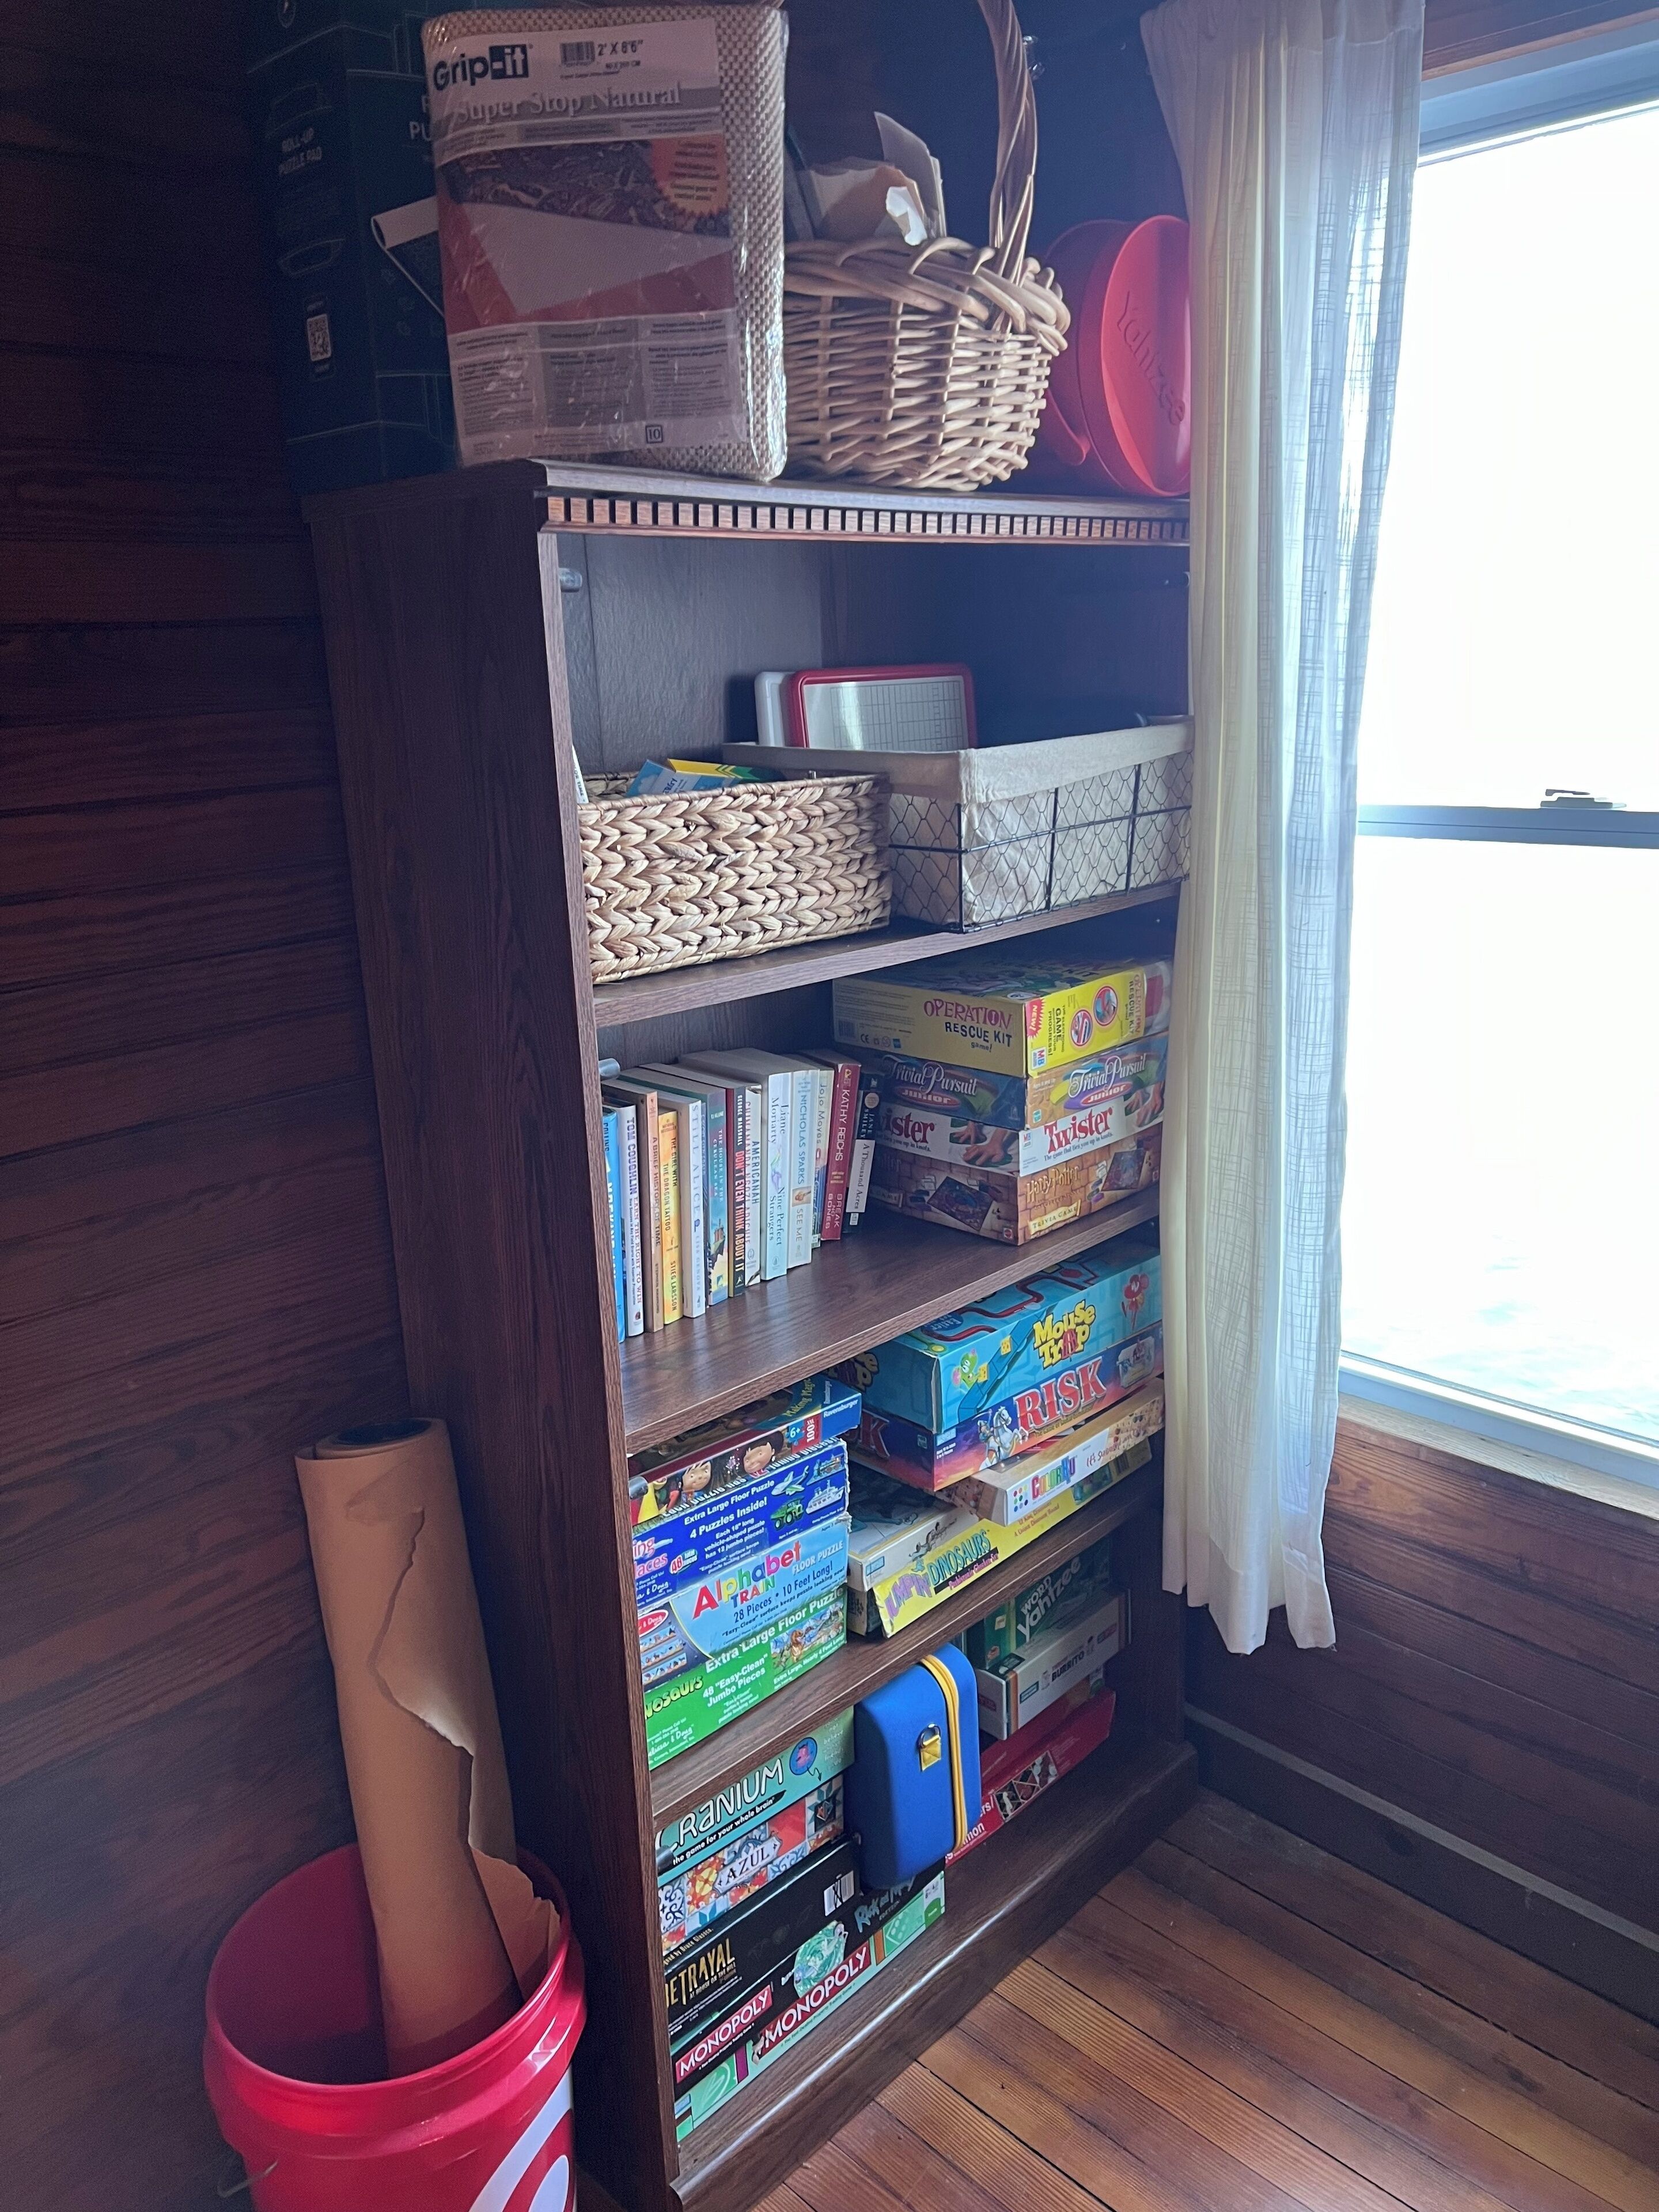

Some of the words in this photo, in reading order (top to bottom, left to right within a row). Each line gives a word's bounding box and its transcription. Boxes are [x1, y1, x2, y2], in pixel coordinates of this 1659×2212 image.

[459, 99, 521, 124] Super
[529, 90, 582, 118] Stop
[590, 80, 681, 109] Natural
[648, 427, 662, 441] 10
[923, 998, 1013, 1029] OPERATION
[1029, 1005, 1038, 1031] NEW!
[945, 1021, 989, 1043] RESCUE
[994, 1030, 1013, 1047] KIT
[971, 1041, 992, 1052] game!
[1036, 1048, 1046, 1066] MB
[882, 1054, 926, 1086] Trivial
[919, 1062, 978, 1096] Pursuit
[1068, 1067, 1108, 1098] Trivial
[1103, 1053, 1147, 1092] Pursuit
[768, 1097, 779, 1144] Moriarty
[781, 1104, 789, 1134] Liane
[839, 1089, 850, 1124] KATHY
[860, 1109, 869, 1138] SMILEY
[627, 1117, 635, 1141] TOM
[817, 1111, 825, 1144] Moyes
[835, 1127, 846, 1161] REICHS
[1044, 1107, 1113, 1154] Twister
[627, 1143, 638, 1195] COUGHLIN
[735, 1150, 745, 1177] DON'T
[752, 1141, 760, 1205] AMERICANAH
[857, 1151, 869, 1187] Thousand
[735, 1180, 745, 1202] EVEN
[777, 1187, 785, 1210] Nine
[854, 1190, 863, 1210] Acres
[1027, 1175, 1052, 1203] Harry
[1050, 1165, 1080, 1193] Potter
[735, 1204, 745, 1232] THINK
[767, 1195, 777, 1241] Strangers
[825, 1193, 834, 1229] BONES
[831, 1205, 836, 1217] NO
[834, 1193, 843, 1228] BREAK
[1032, 1215, 1056, 1229] TRIVIA
[735, 1234, 745, 1262] ABOUT
[796, 1228, 802, 1242] ME
[637, 1270, 641, 1283] TO
[735, 1263, 745, 1272] IT
[1032, 1298, 1096, 1350] Mouse
[823, 1399, 858, 1418] Ravensburger
[1013, 1356, 1107, 1434] RISK
[790, 1427, 801, 1438] 6+
[806, 1425, 815, 1442] 100
[684, 1512, 706, 1525] Extra
[707, 1501, 729, 1516] Large
[730, 1491, 750, 1504] Floor
[751, 1480, 775, 1495] Puzzle
[690, 1529, 697, 1539] 4
[699, 1514, 735, 1536] Puzzles
[737, 1497, 767, 1518] Inside!
[715, 1528, 730, 1539] Each
[742, 1518, 755, 1528] long
[792, 1555, 816, 1576] FLOOR
[817, 1540, 844, 1563] PUZZLE
[926, 1529, 991, 1585] DINOSAURS
[652, 1581, 669, 1593] Doug
[692, 1540, 802, 1620] Alphabet
[731, 1575, 776, 1608] TRAIN
[733, 1611, 744, 1624] 28
[747, 1597, 772, 1616] Pieces
[782, 1586, 791, 1597] 10
[794, 1575, 810, 1592] Feet
[813, 1560, 834, 1582] Long!
[1020, 1574, 1052, 1616] WORD
[1016, 1556, 1082, 1643] Yahtzee
[705, 1646, 739, 1673] Extra
[741, 1626, 776, 1652] Large
[778, 1607, 807, 1632] Floor
[809, 1587, 844, 1613] Puzzle
[703, 1685, 714, 1699] 48
[715, 1653, 769, 1689] "Easy-Clean"
[1051, 1650, 1085, 1683] BURRITO
[707, 1685, 736, 1707] Jumbo
[737, 1667, 766, 1689] Pieces
[676, 1726, 693, 1741] Doug
[673, 1855, 684, 1865] the
[685, 1843, 706, 1858] game
[706, 1834, 717, 1844] for
[718, 1824, 734, 1839] your
[734, 1809, 755, 1826] whole
[755, 1798, 774, 1815] brain
[725, 1847, 770, 1885] AZUL
[764, 1946, 867, 2048] MONOPOLY
[680, 1990, 768, 2077] MONOPOLY
